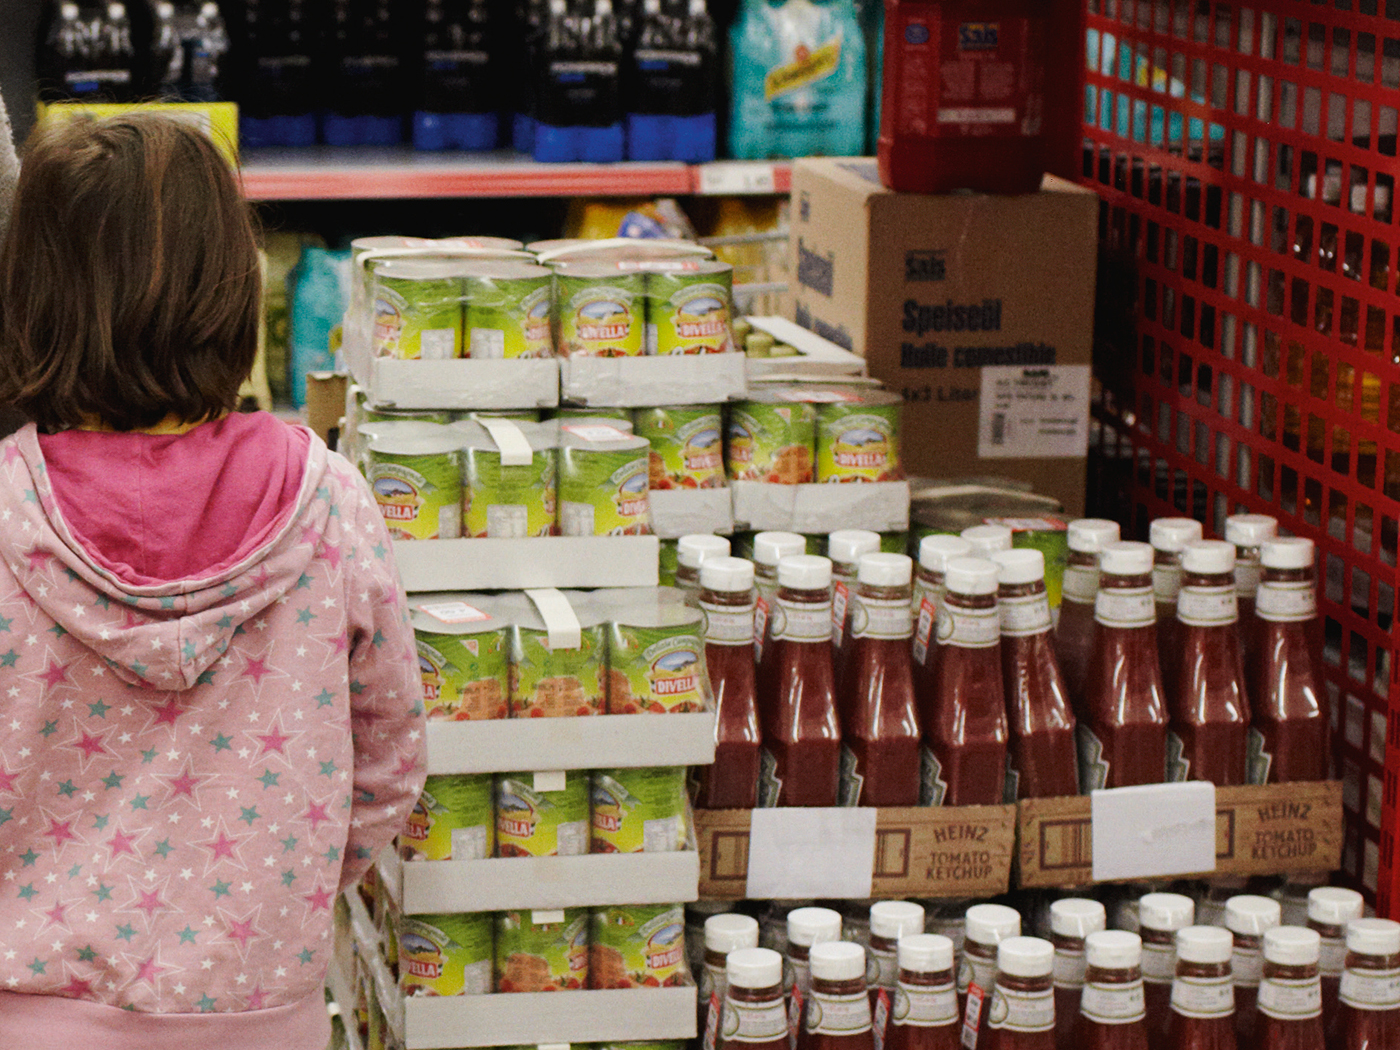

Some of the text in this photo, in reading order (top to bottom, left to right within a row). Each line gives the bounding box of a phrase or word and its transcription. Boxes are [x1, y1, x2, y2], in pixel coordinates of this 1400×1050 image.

[902, 298, 1003, 337] Speiseöl
[1256, 801, 1312, 823] HEINZ
[933, 824, 990, 843] HEINZ
[1254, 828, 1315, 844] TOMATO
[930, 850, 991, 865] TOMATO
[1251, 842, 1318, 859] KETCHUP
[926, 864, 993, 880] KETCHUP
